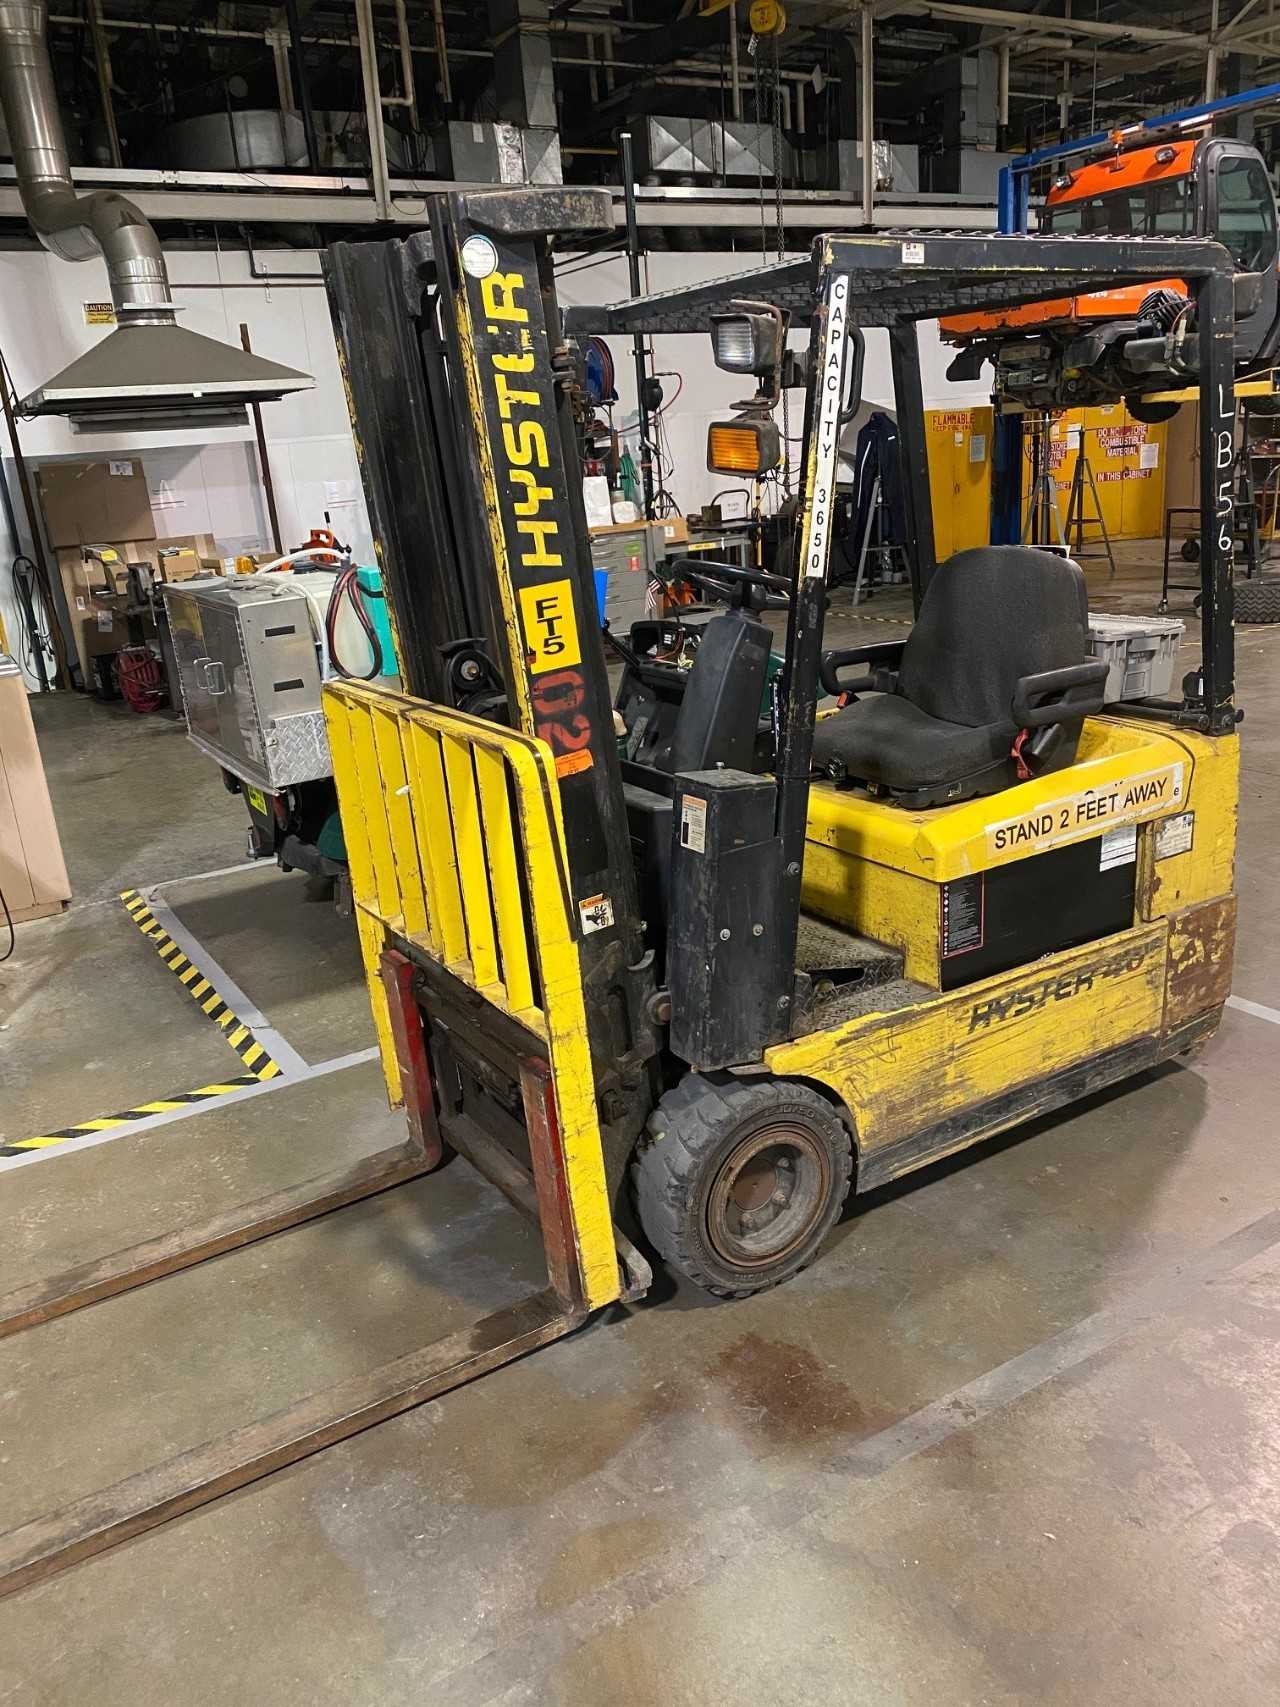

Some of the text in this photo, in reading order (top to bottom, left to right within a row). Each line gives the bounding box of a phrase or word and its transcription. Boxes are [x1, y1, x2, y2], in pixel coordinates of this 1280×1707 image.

[84, 303, 112, 312] CAUTION
[481, 271, 563, 567] HYSTER
[932, 412, 976, 426] FLAMMABLE
[811, 284, 845, 569] CAPACITY 3650
[1098, 428, 1108, 437] DO
[1126, 424, 1148, 436] TORE
[1100, 434, 1145, 448] COMBUSTIBLE
[1106, 446, 1138, 457] MATERIAL
[1216, 383, 1234, 551] LB56
[1097, 470, 1150, 482] IN THIS CABINET
[535, 596, 565, 656] FT5
[995, 815, 1053, 849] STAND
[1060, 809, 1069, 829] 2
[1077, 792, 1119, 824] FEET
[1123, 777, 1168, 808] AWAY
